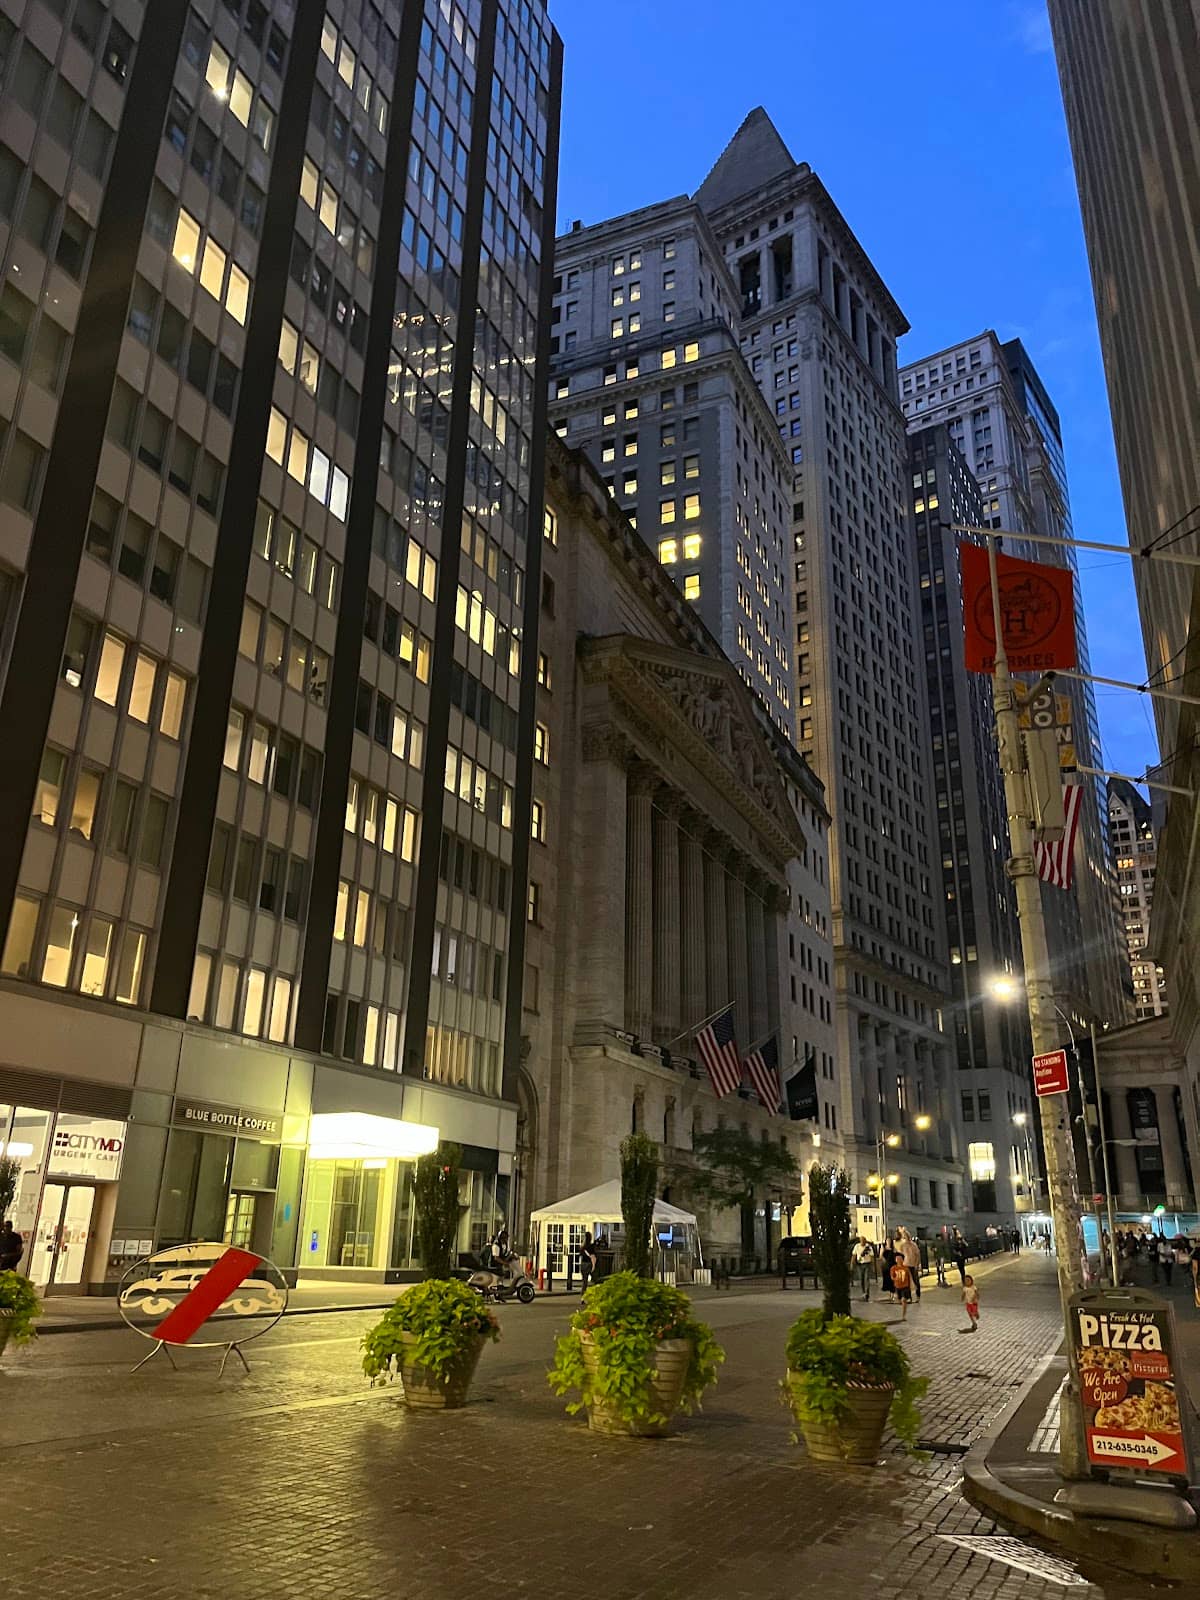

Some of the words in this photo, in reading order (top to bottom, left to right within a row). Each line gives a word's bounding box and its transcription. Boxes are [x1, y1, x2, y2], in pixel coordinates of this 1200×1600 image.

[982, 653, 1055, 669] HRMES
[1041, 1055, 1062, 1067] STANDING
[185, 1108, 209, 1121] BLUE
[210, 1112, 243, 1127] BOTTLE
[244, 1117, 277, 1132] COFFEE
[68, 1133, 122, 1152] CITYMD
[53, 1149, 93, 1160] URGENT
[1131, 1313, 1138, 1322] &
[1139, 1313, 1154, 1323] Hot
[1080, 1314, 1162, 1351] Pizza
[1083, 1371, 1101, 1387] We
[1103, 1370, 1121, 1385] Are
[1093, 1386, 1118, 1408] Open
[1096, 1440, 1158, 1455] 212-635-0345
